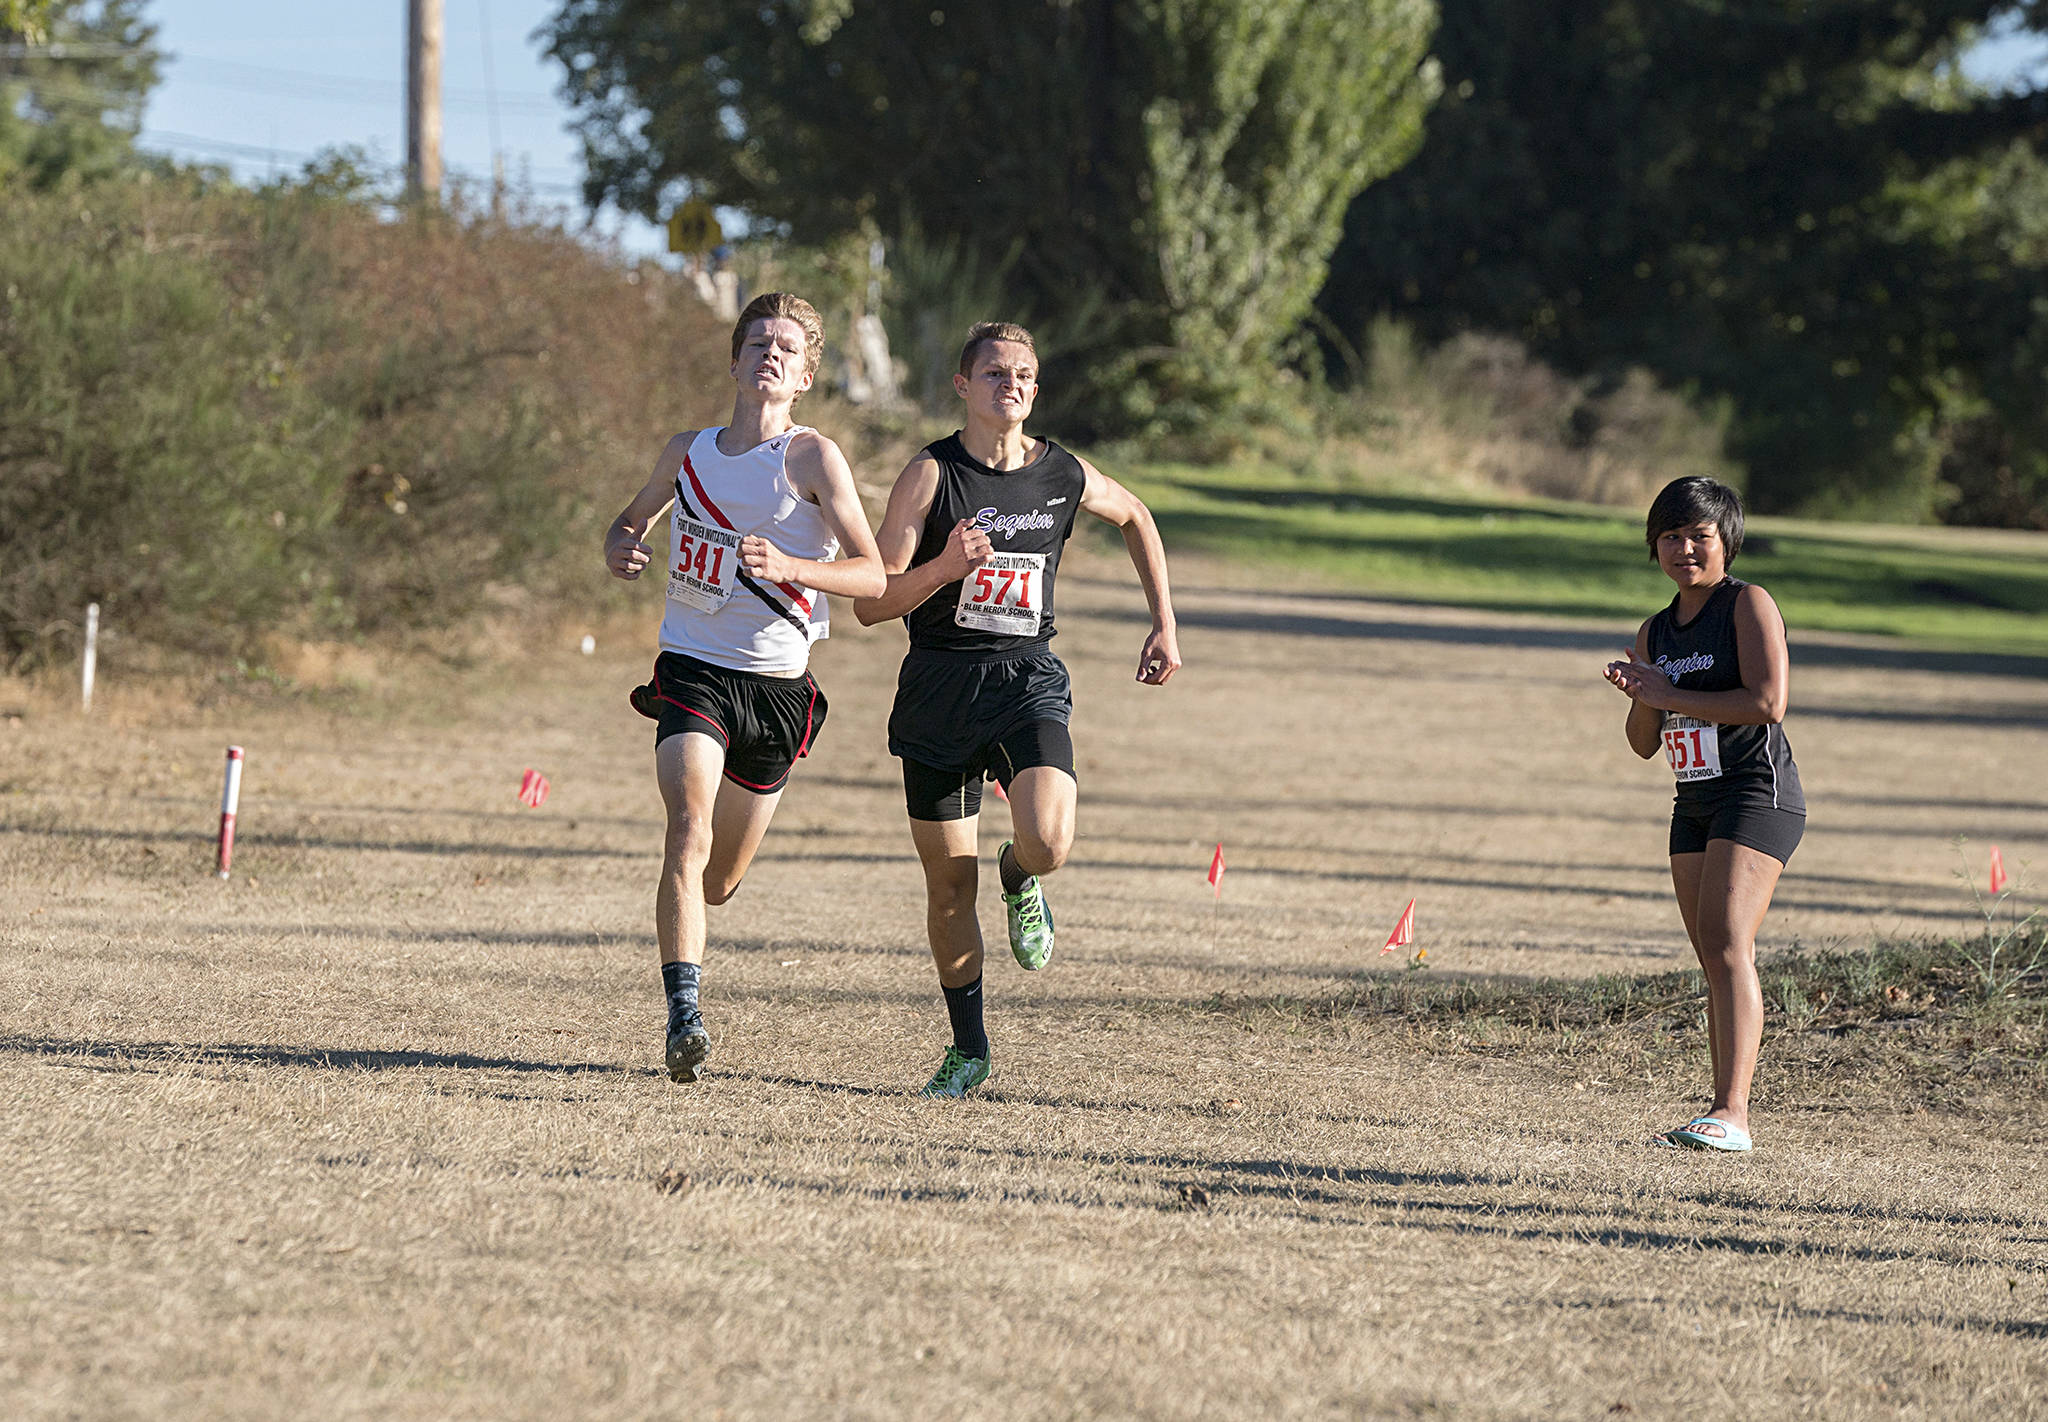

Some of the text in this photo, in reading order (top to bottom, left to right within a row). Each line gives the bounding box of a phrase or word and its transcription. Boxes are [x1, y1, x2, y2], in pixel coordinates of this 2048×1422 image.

[973, 507, 1054, 540] Sequim
[678, 534, 724, 586] 541
[672, 570, 686, 583] BLUE
[686, 575, 702, 590] HERON
[702, 582, 724, 597] SCHOOL
[971, 568, 1031, 609] 571
[963, 603, 1036, 618] BLUE HERON SCHOOL
[1664, 729, 1706, 770] 551
[1689, 768, 1716, 779] SCHOOL
